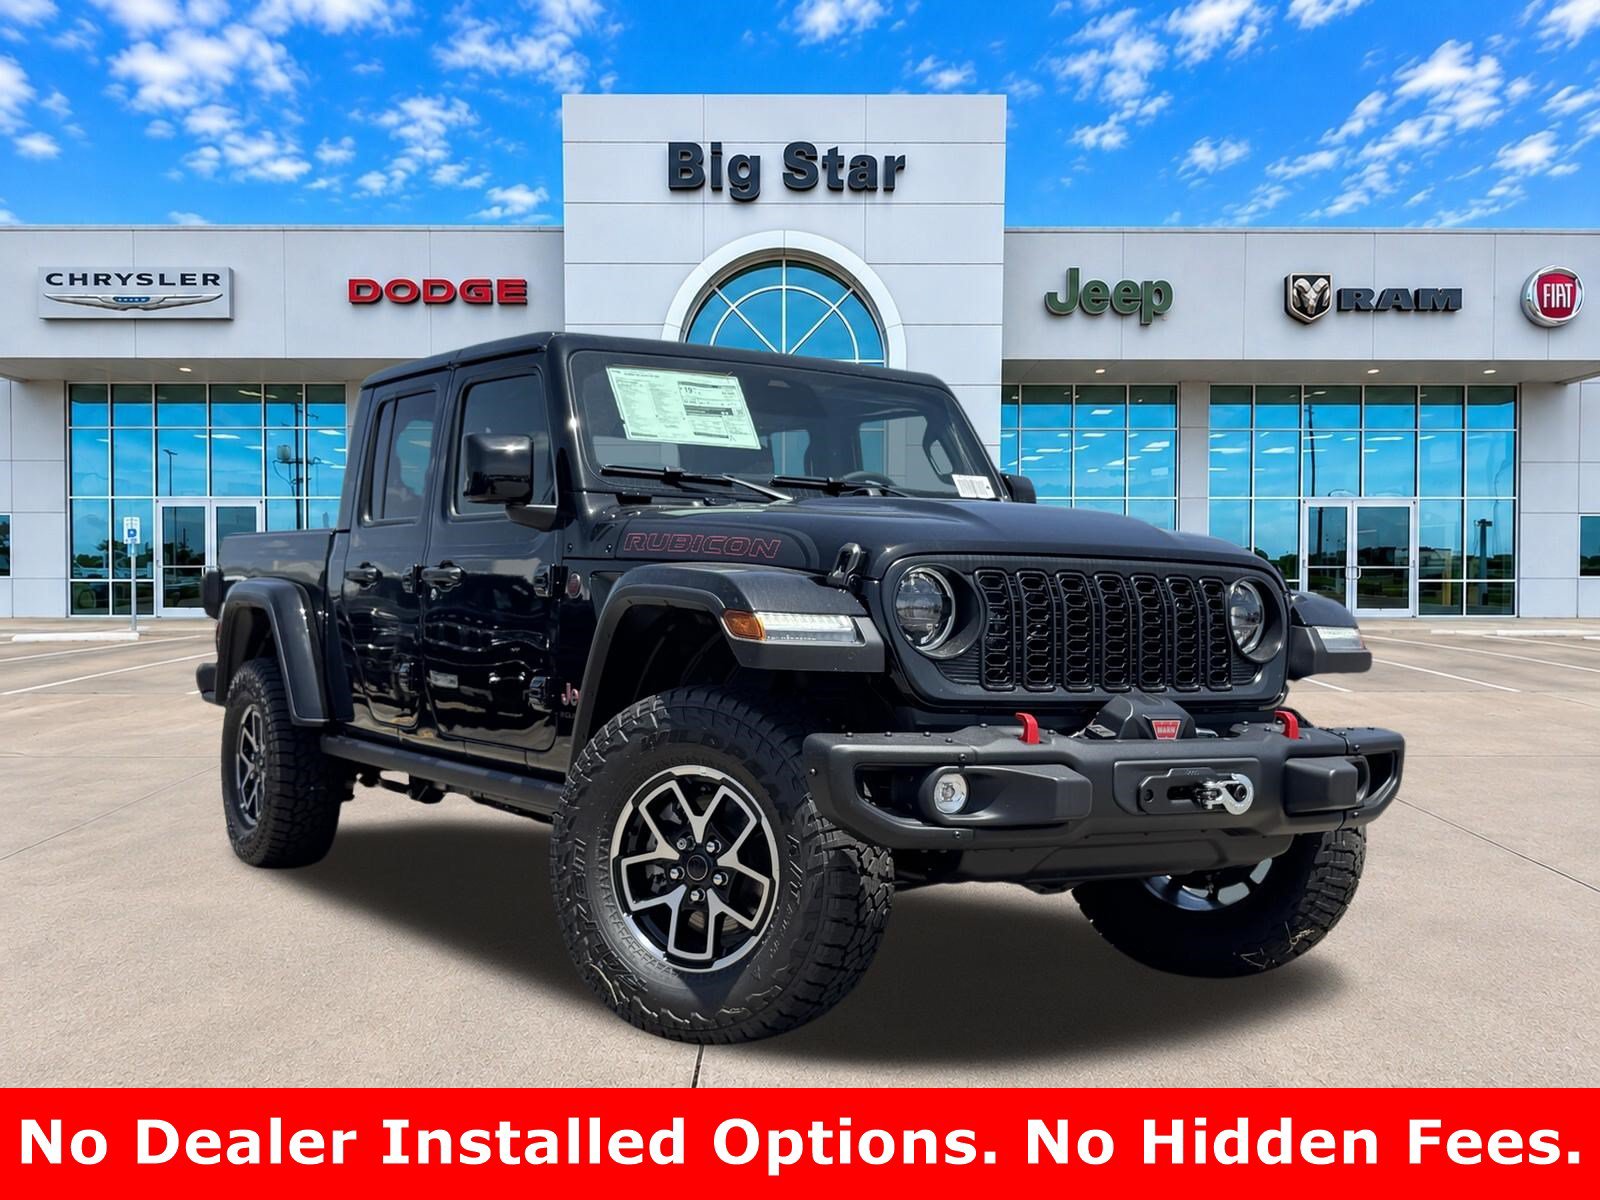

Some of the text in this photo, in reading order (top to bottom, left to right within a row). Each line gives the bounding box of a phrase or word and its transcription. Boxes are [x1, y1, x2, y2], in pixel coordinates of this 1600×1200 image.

[668, 141, 906, 202] Big Star
[45, 272, 221, 287] CHRYSLER
[348, 278, 528, 306] DODGE
[1044, 267, 1174, 326] Jeep
[1336, 287, 1463, 312] RAM
[1543, 283, 1573, 308] FIAT
[624, 532, 781, 559] RUBICON
[561, 682, 580, 706] Je
